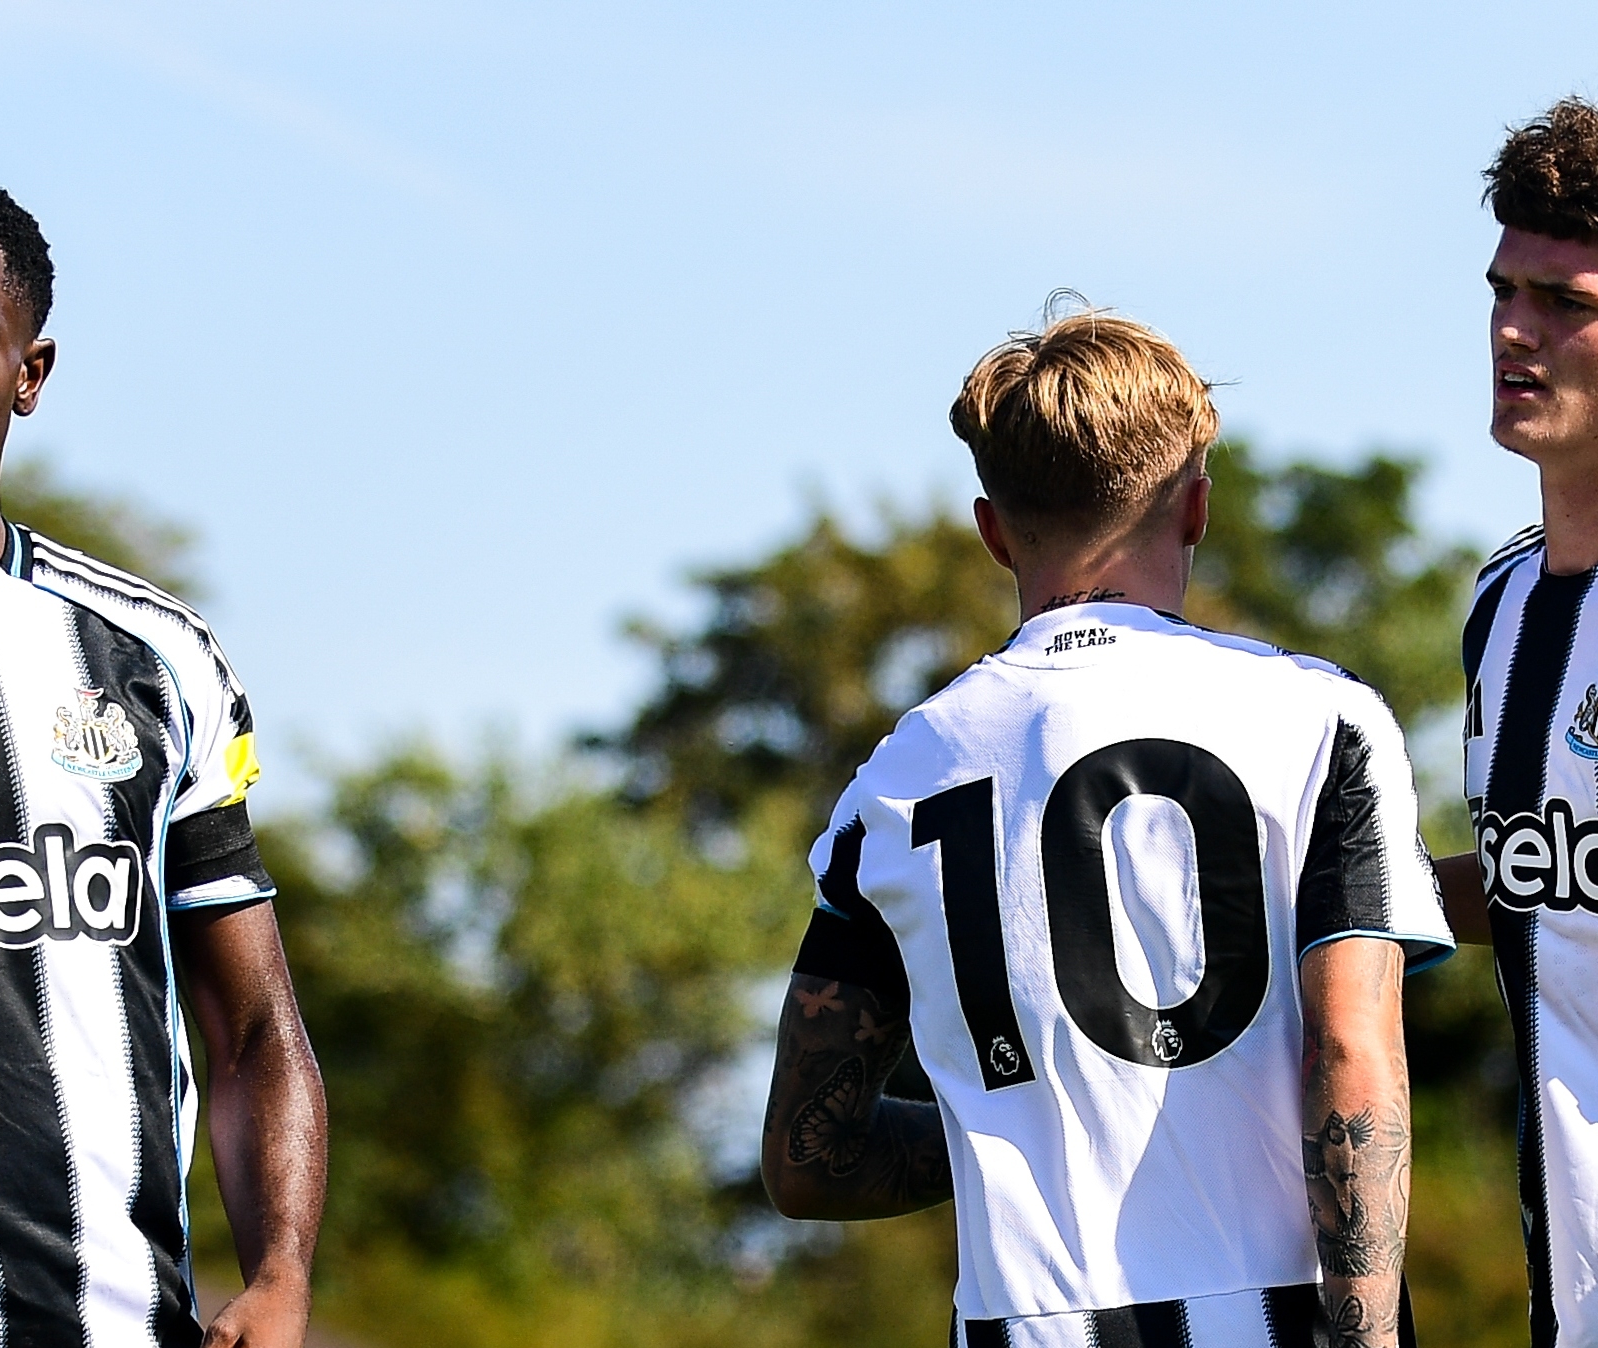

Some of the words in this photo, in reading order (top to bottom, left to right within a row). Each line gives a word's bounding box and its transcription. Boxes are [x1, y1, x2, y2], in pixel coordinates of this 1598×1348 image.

[1044, 641, 1072, 656] THE
[1077, 636, 1116, 649] LADS
[1053, 628, 1109, 645] HOWAY
[911, 738, 1271, 1092] 10
